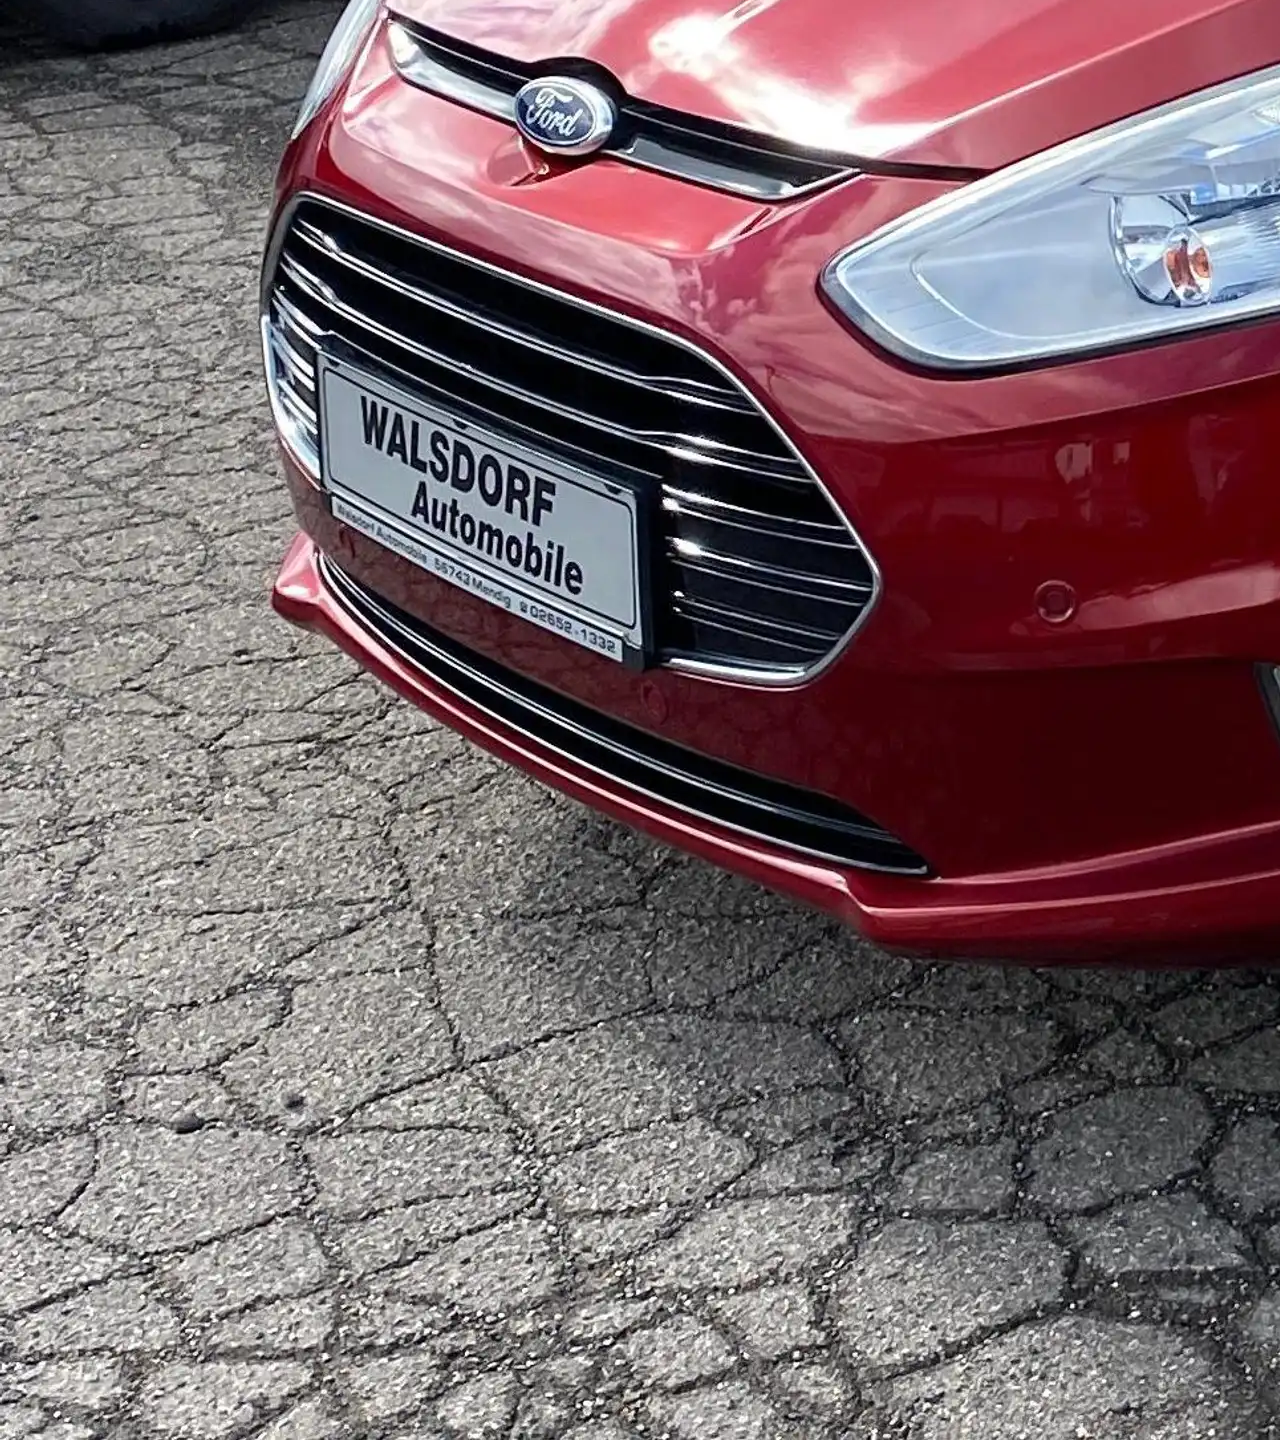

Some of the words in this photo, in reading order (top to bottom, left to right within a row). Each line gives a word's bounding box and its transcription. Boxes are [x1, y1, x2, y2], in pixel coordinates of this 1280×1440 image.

[526, 87, 583, 136] Ford
[360, 395, 557, 527] WALSDORF
[410, 480, 584, 595] Automobile
